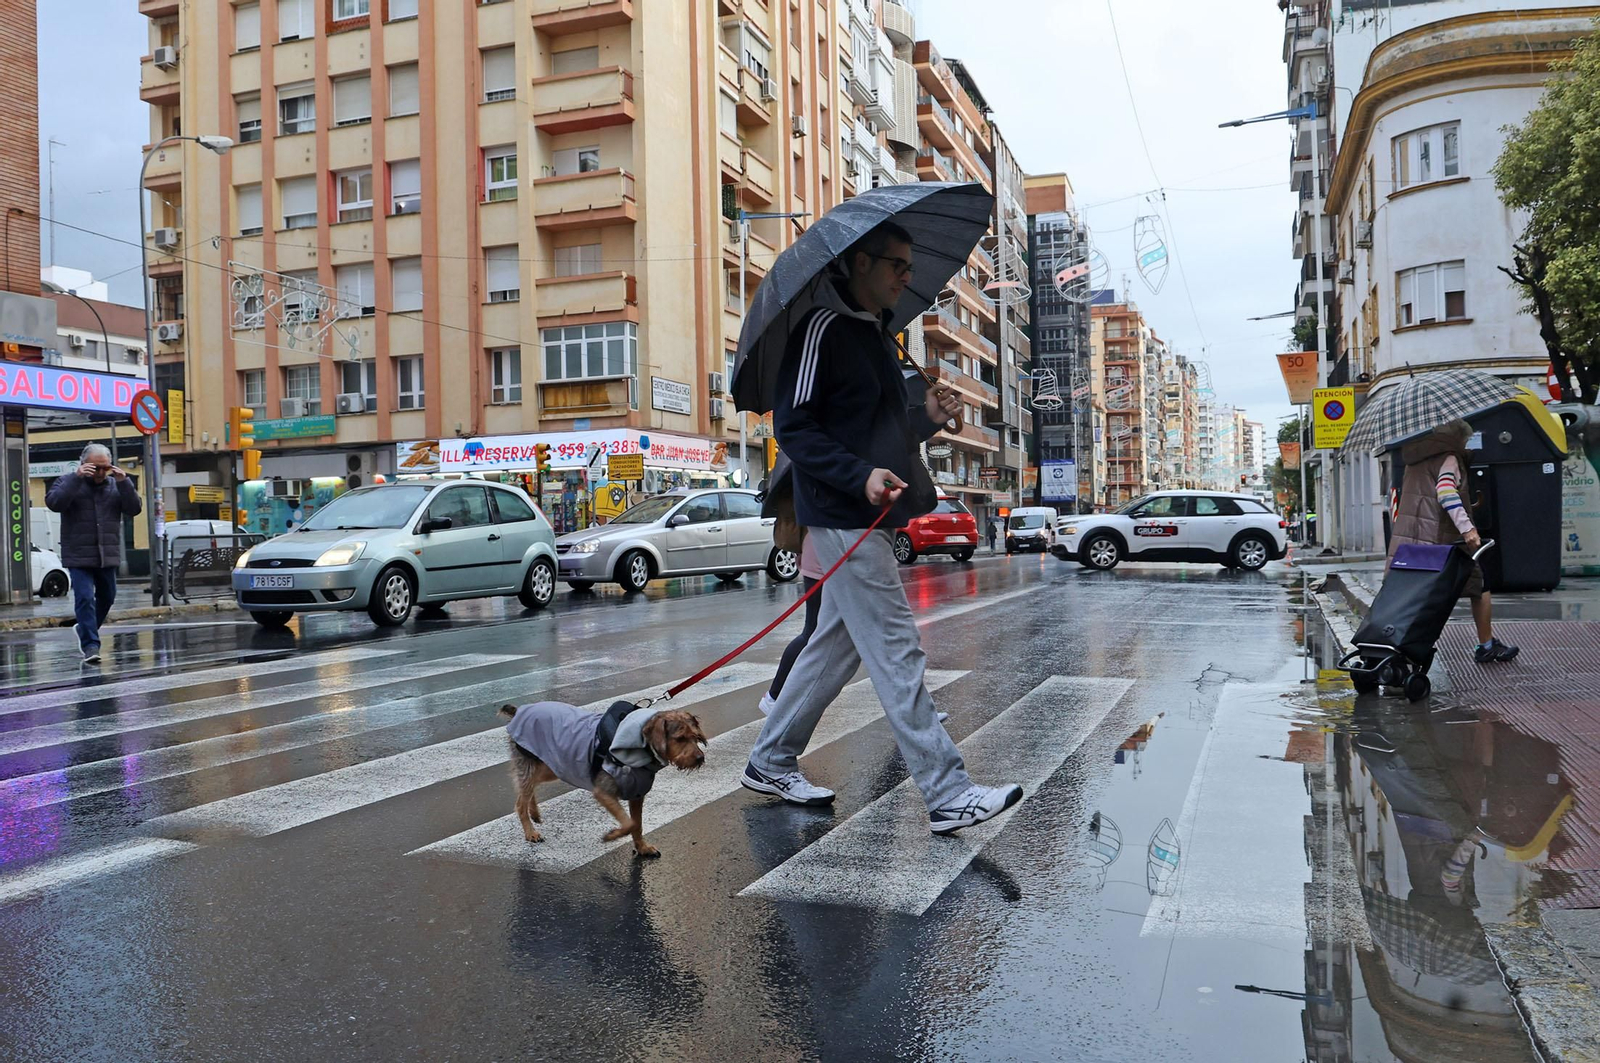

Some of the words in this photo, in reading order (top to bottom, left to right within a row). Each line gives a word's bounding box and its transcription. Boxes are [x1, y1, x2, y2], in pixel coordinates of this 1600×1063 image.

[1287, 356, 1304, 368] 50
[439, 449, 472, 463] ILLA
[612, 440, 629, 454] 38
[11, 480, 23, 562] codere
[1137, 527, 1164, 535] GRUPO
[255, 576, 276, 587] 7815
[277, 576, 292, 586] CSF
